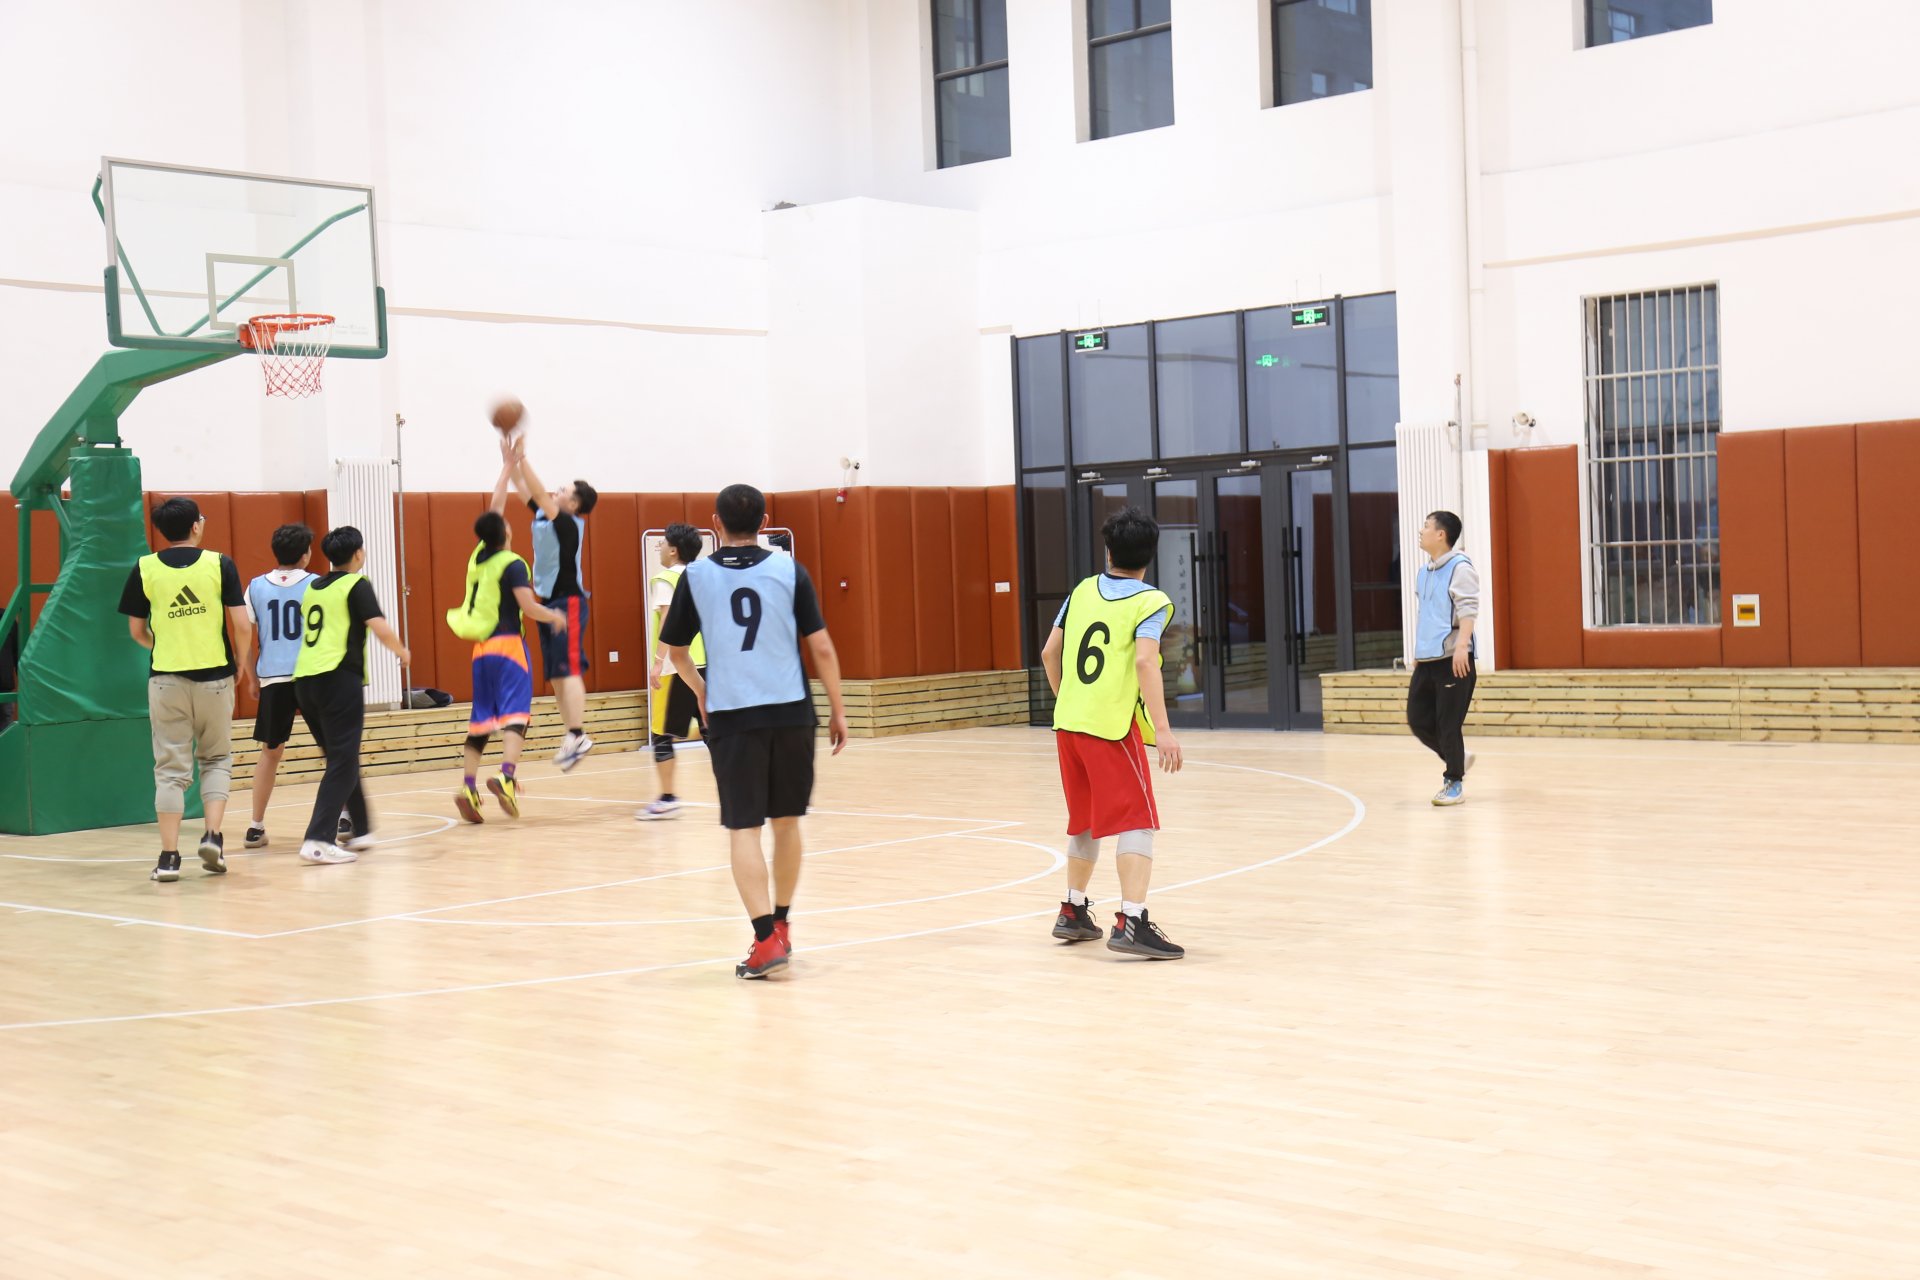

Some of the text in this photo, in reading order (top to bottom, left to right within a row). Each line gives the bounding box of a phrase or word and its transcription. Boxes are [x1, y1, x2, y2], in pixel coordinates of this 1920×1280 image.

[168, 605, 206, 618] adidas
[267, 599, 301, 640] 10
[305, 604, 323, 647] 9
[731, 587, 762, 651] 9
[1077, 621, 1110, 684] 6
